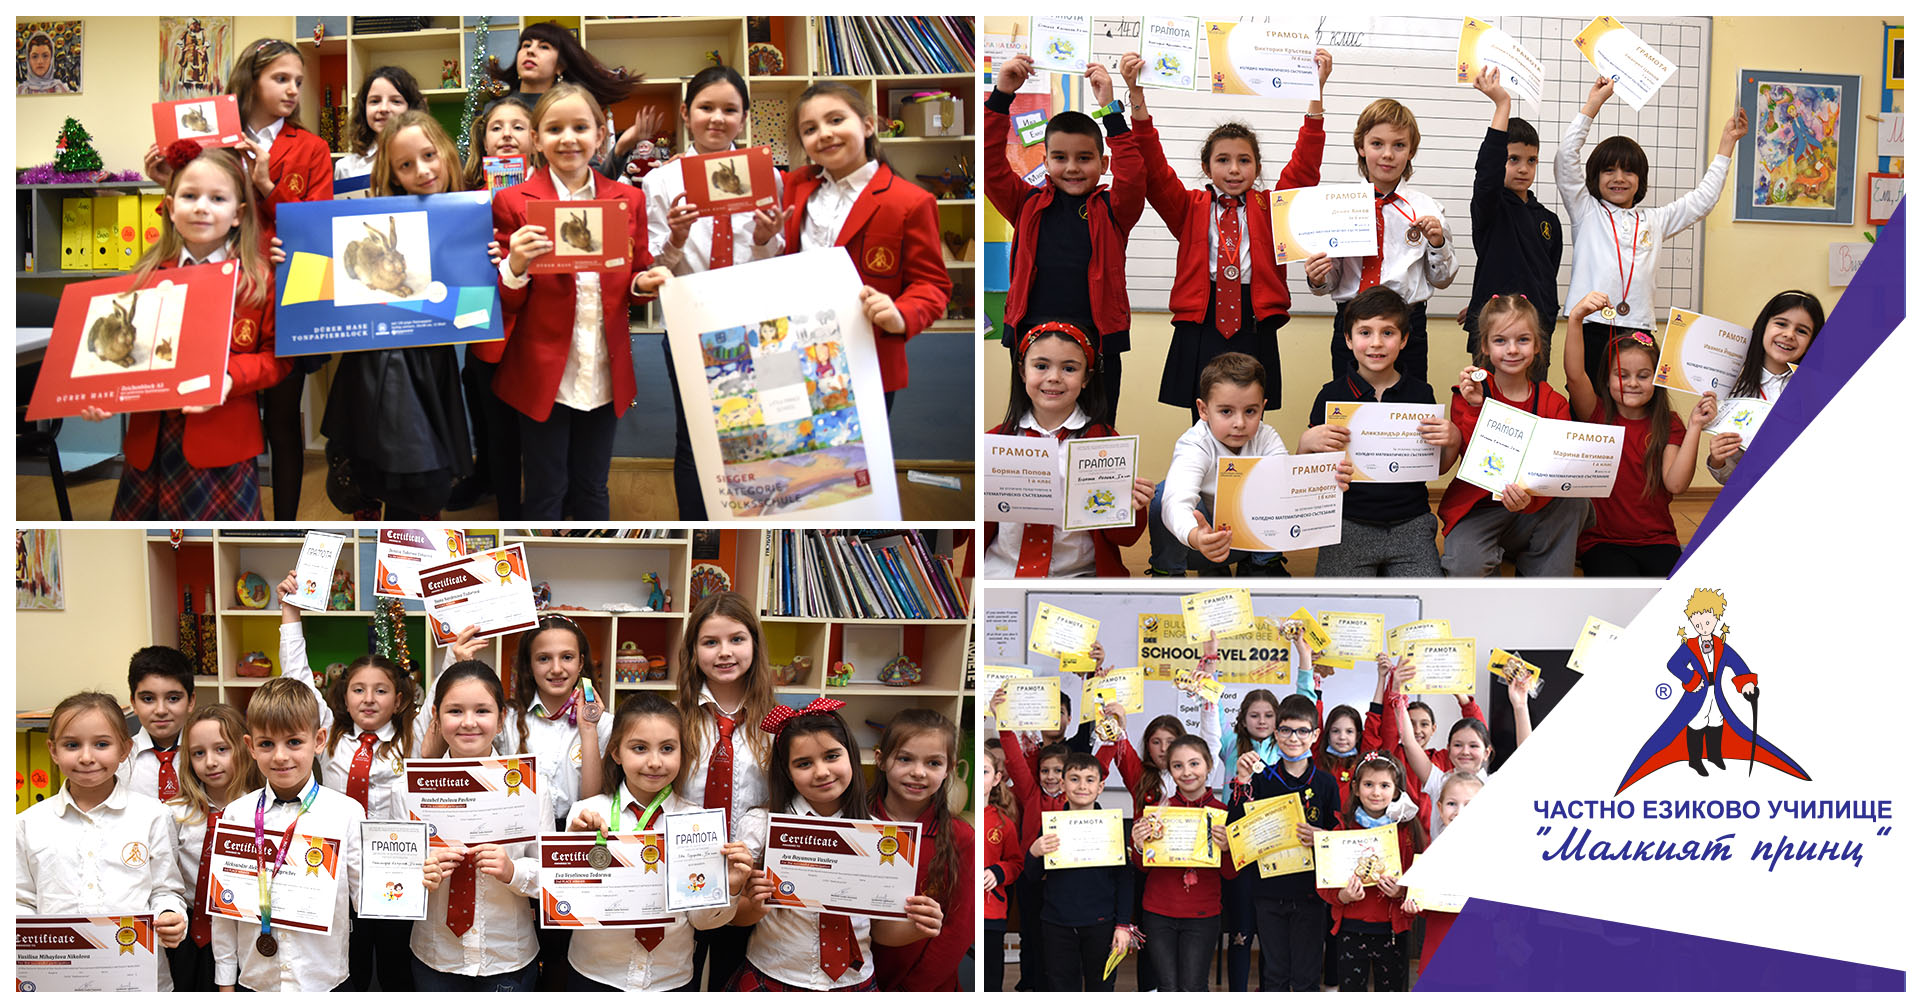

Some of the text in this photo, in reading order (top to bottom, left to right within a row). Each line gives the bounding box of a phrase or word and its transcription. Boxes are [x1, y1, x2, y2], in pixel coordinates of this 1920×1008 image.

[1150, 24, 1190, 38] ГРАМОТА
[1266, 30, 1310, 40] ГРАМОТА
[1636, 46, 1667, 72] ГРАМОТА
[1325, 192, 1368, 201] ГРАМОТА
[313, 323, 368, 334] DÜRER HASE
[292, 330, 368, 342] TONPAPIERBLOCK
[1719, 329, 1748, 345] ГРАМОТА
[90, 391, 115, 399] HASE
[1361, 429, 1400, 437] Александър
[1486, 418, 1524, 441] ГРАМОТА
[1566, 431, 1616, 444] ГРАМОТА
[992, 446, 1049, 458] ГРАМОТА
[1553, 450, 1614, 460] Марина Евтимова
[1078, 457, 1127, 470] ГРАМОТА
[1292, 463, 1337, 476] ГРАМОТА
[991, 467, 1020, 475] Боряна
[716, 473, 756, 483] SIEGER
[719, 483, 784, 496] KATEGORIE
[1290, 484, 1337, 495] Раян Калфоглу
[721, 494, 803, 510] VOLKSSCHULE
[1275, 512, 1311, 520] МАТЕМАТИЧЕСКО
[386, 530, 425, 544] Certificate
[427, 574, 468, 591] Certificate
[1057, 616, 1083, 628] ГРАМОТА
[1141, 647, 1201, 659] SCHOOL
[1249, 648, 1289, 662] 2022
[1180, 704, 1200, 713] Spell
[1186, 719, 1200, 728] Say
[416, 777, 470, 787] Certificate
[675, 831, 718, 845] ГРАМОТА
[779, 832, 839, 848] Certificate
[371, 841, 418, 853] ГРАМОТА
